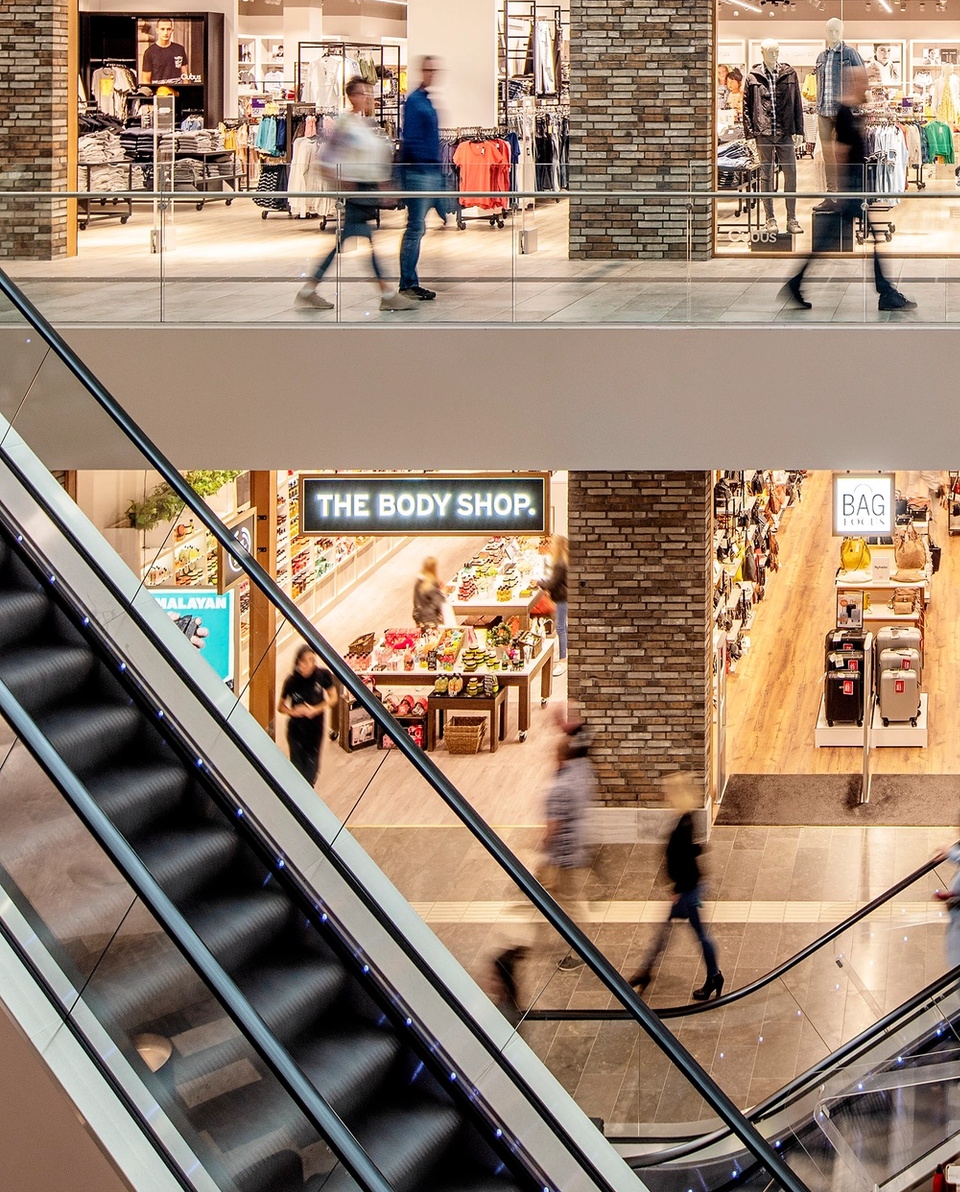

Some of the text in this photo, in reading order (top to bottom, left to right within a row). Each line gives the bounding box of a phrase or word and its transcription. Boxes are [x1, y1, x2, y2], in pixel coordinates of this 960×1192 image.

[180, 72, 201, 80] Cubus
[317, 494, 536, 517] THE BODY SHOP.
[843, 494, 885, 516] BAG
